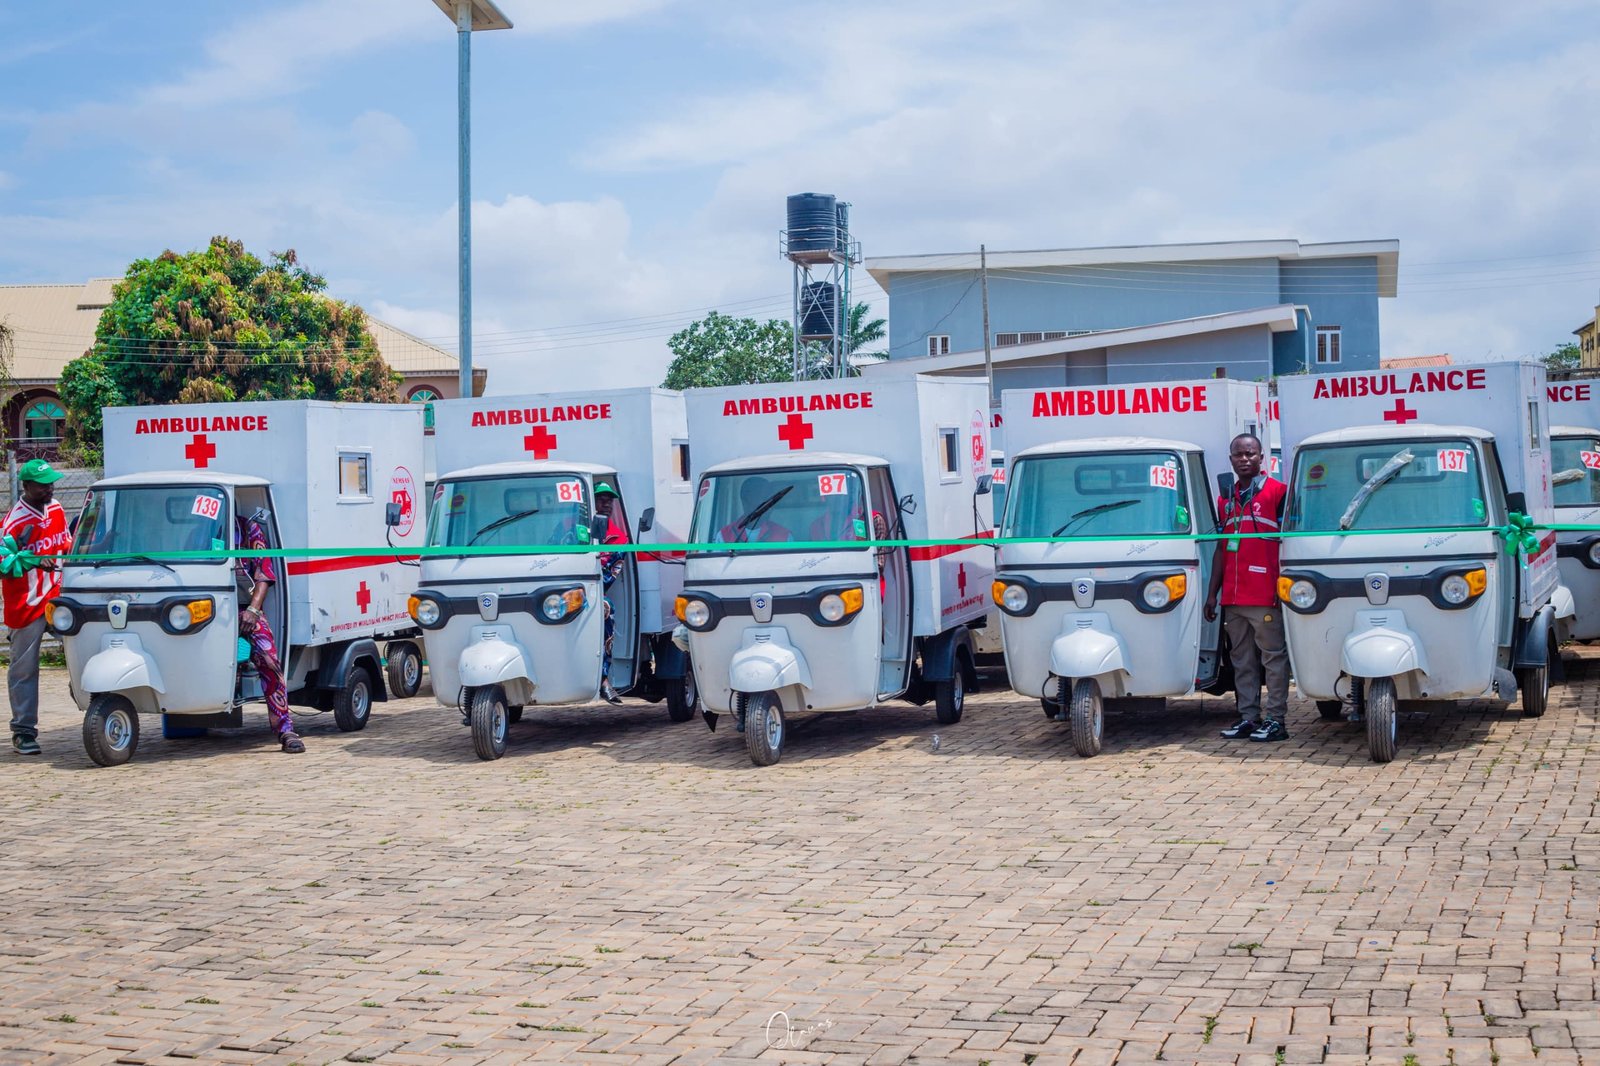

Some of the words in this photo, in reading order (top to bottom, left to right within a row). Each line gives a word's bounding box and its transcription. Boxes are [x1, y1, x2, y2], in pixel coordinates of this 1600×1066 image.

[1313, 369, 1486, 399] AMBULANCE
[723, 391, 873, 416] AMBULANCE
[1032, 385, 1207, 417] AMBULANCE
[135, 415, 268, 434] AMBULANCE
[471, 403, 611, 427] AMBULANCE
[1439, 450, 1465, 470] 137
[819, 474, 846, 494] 87
[1152, 467, 1175, 487] 135
[559, 483, 582, 501] 81
[195, 496, 219, 517] 139
